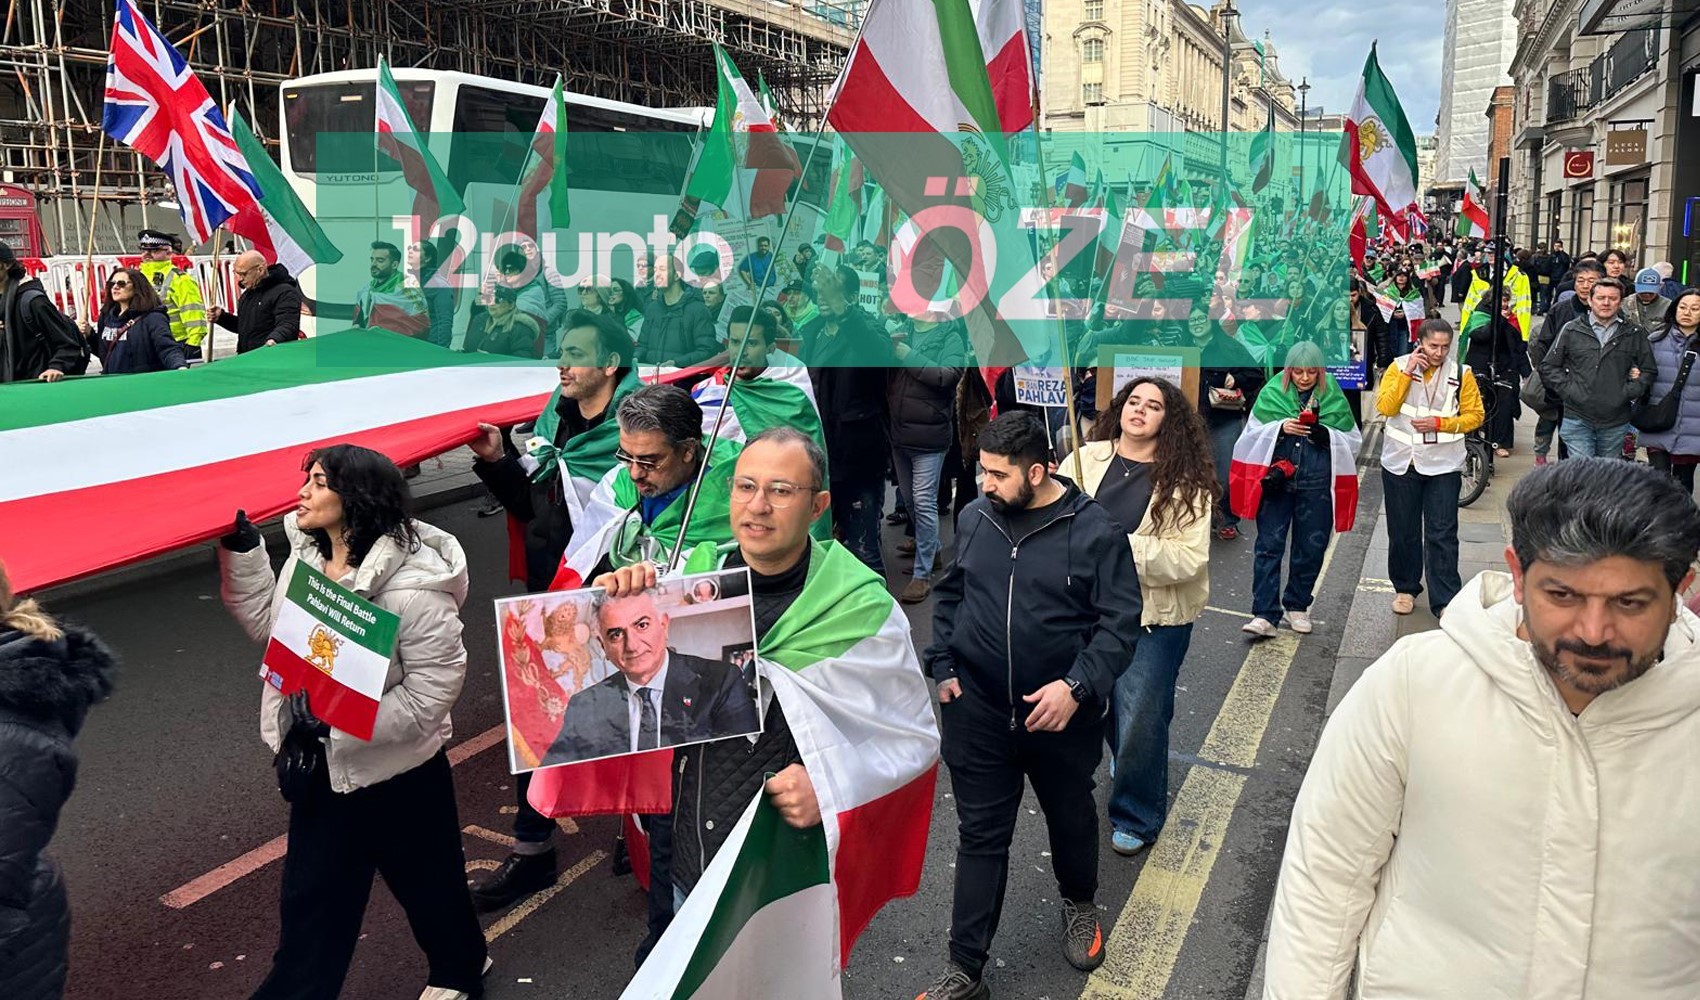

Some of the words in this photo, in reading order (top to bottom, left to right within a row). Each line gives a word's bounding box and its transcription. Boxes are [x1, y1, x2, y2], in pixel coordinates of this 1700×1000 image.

[1018, 388, 1067, 404] PAHLAV
[1038, 380, 1066, 392] REZA
[306, 593, 330, 614] Pahlavi
[328, 607, 342, 623] Will
[340, 615, 366, 637] Return
[307, 575, 320, 590] This
[325, 588, 337, 601] the
[336, 595, 354, 612] Final
[352, 604, 377, 625] Battle
